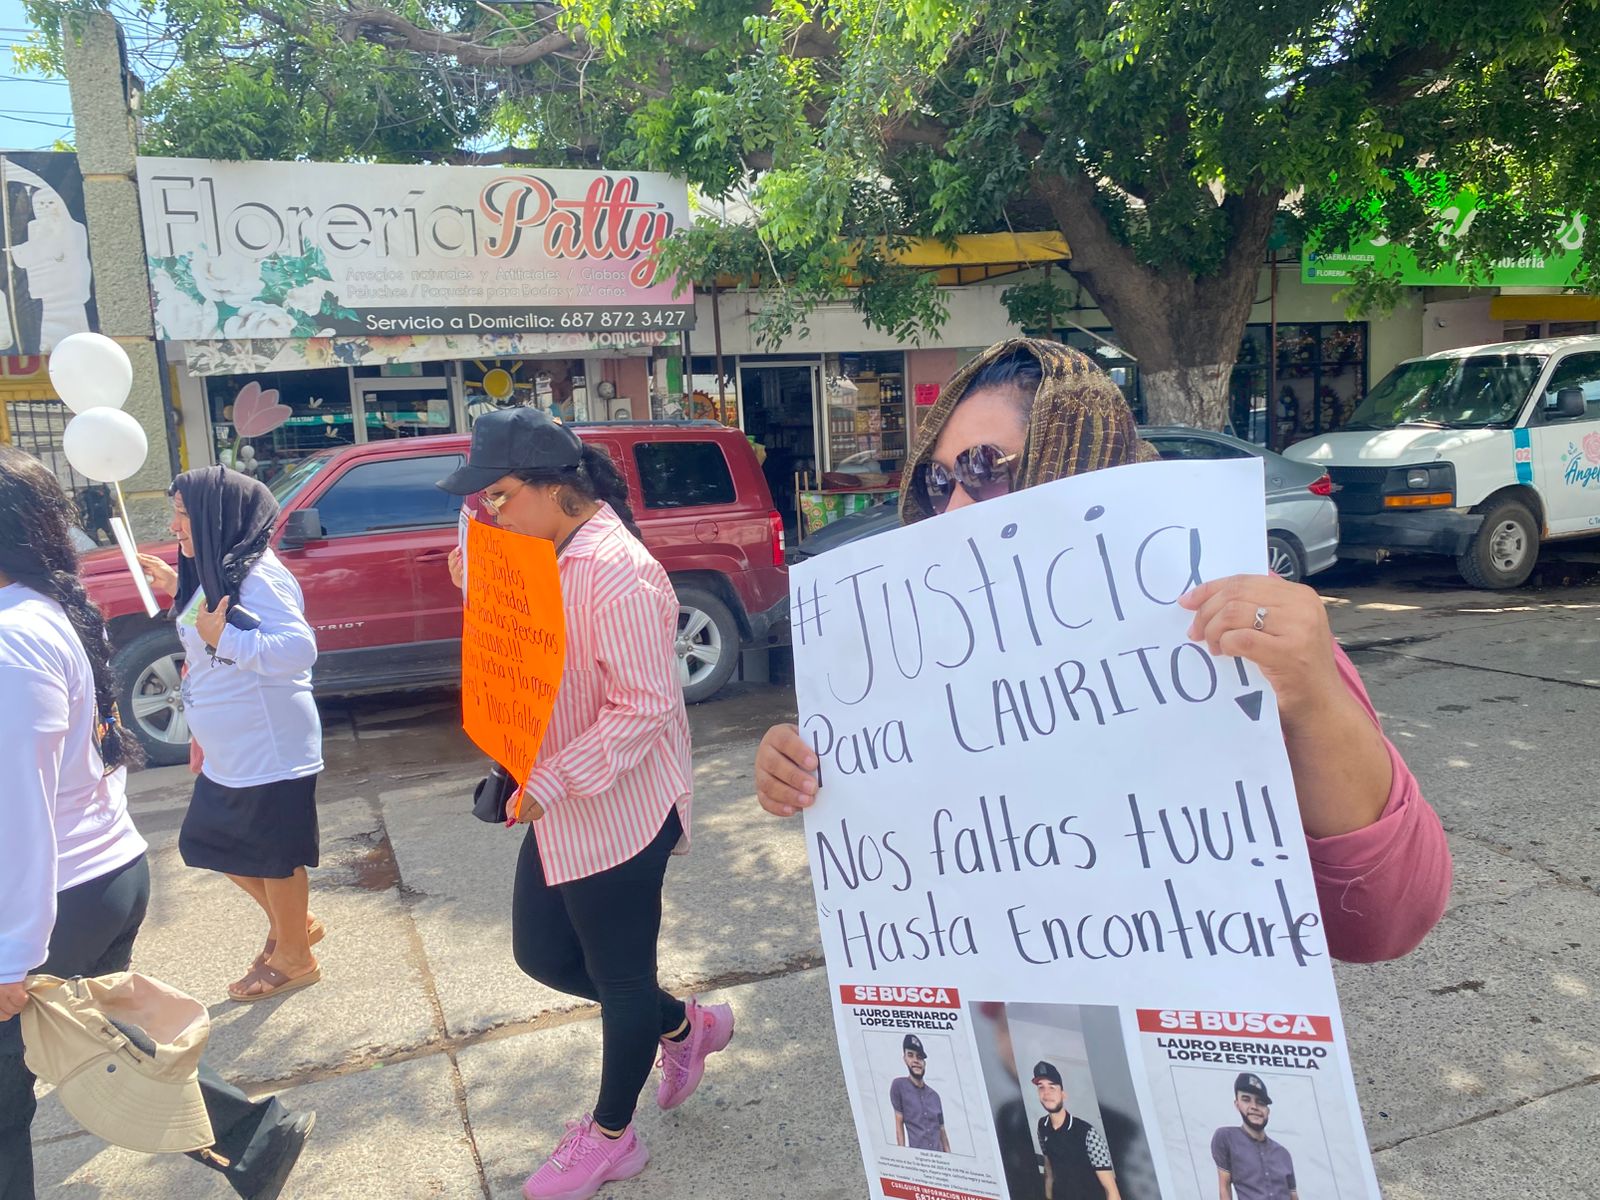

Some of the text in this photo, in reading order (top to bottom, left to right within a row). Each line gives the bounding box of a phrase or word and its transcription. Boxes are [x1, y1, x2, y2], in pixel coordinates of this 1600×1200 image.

[150, 174, 674, 288] Florería Patty
[1347, 254, 1375, 262] ANGELES
[411, 268, 473, 281] naturales
[480, 270, 489, 282] y
[496, 267, 561, 281] Artificiales
[581, 267, 626, 281] Globos
[346, 283, 408, 298] Peluches
[420, 283, 483, 299] Paquetes
[487, 285, 519, 299] para
[522, 283, 562, 298] Bodas
[564, 286, 573, 298] y
[577, 284, 594, 297] XV
[598, 284, 626, 297] años
[366, 310, 686, 331] Servicio a Domicilio: 687 872 3427
[803, 713, 913, 788] Para
[815, 818, 913, 892] Nos
[929, 795, 1098, 876] faltas
[1006, 878, 1324, 967] Encontrarte
[854, 986, 951, 1004] SE BUSCA
[853, 1007, 958, 1021] LAURO BERNARDO
[860, 1017, 955, 1031] LOPEZ ESTRELLA
[1159, 1010, 1317, 1036] SE BUSCA
[1157, 1036, 1328, 1058] LAURO BERNARDO
[1167, 1049, 1320, 1070] LOPEZ ESTRELLA
